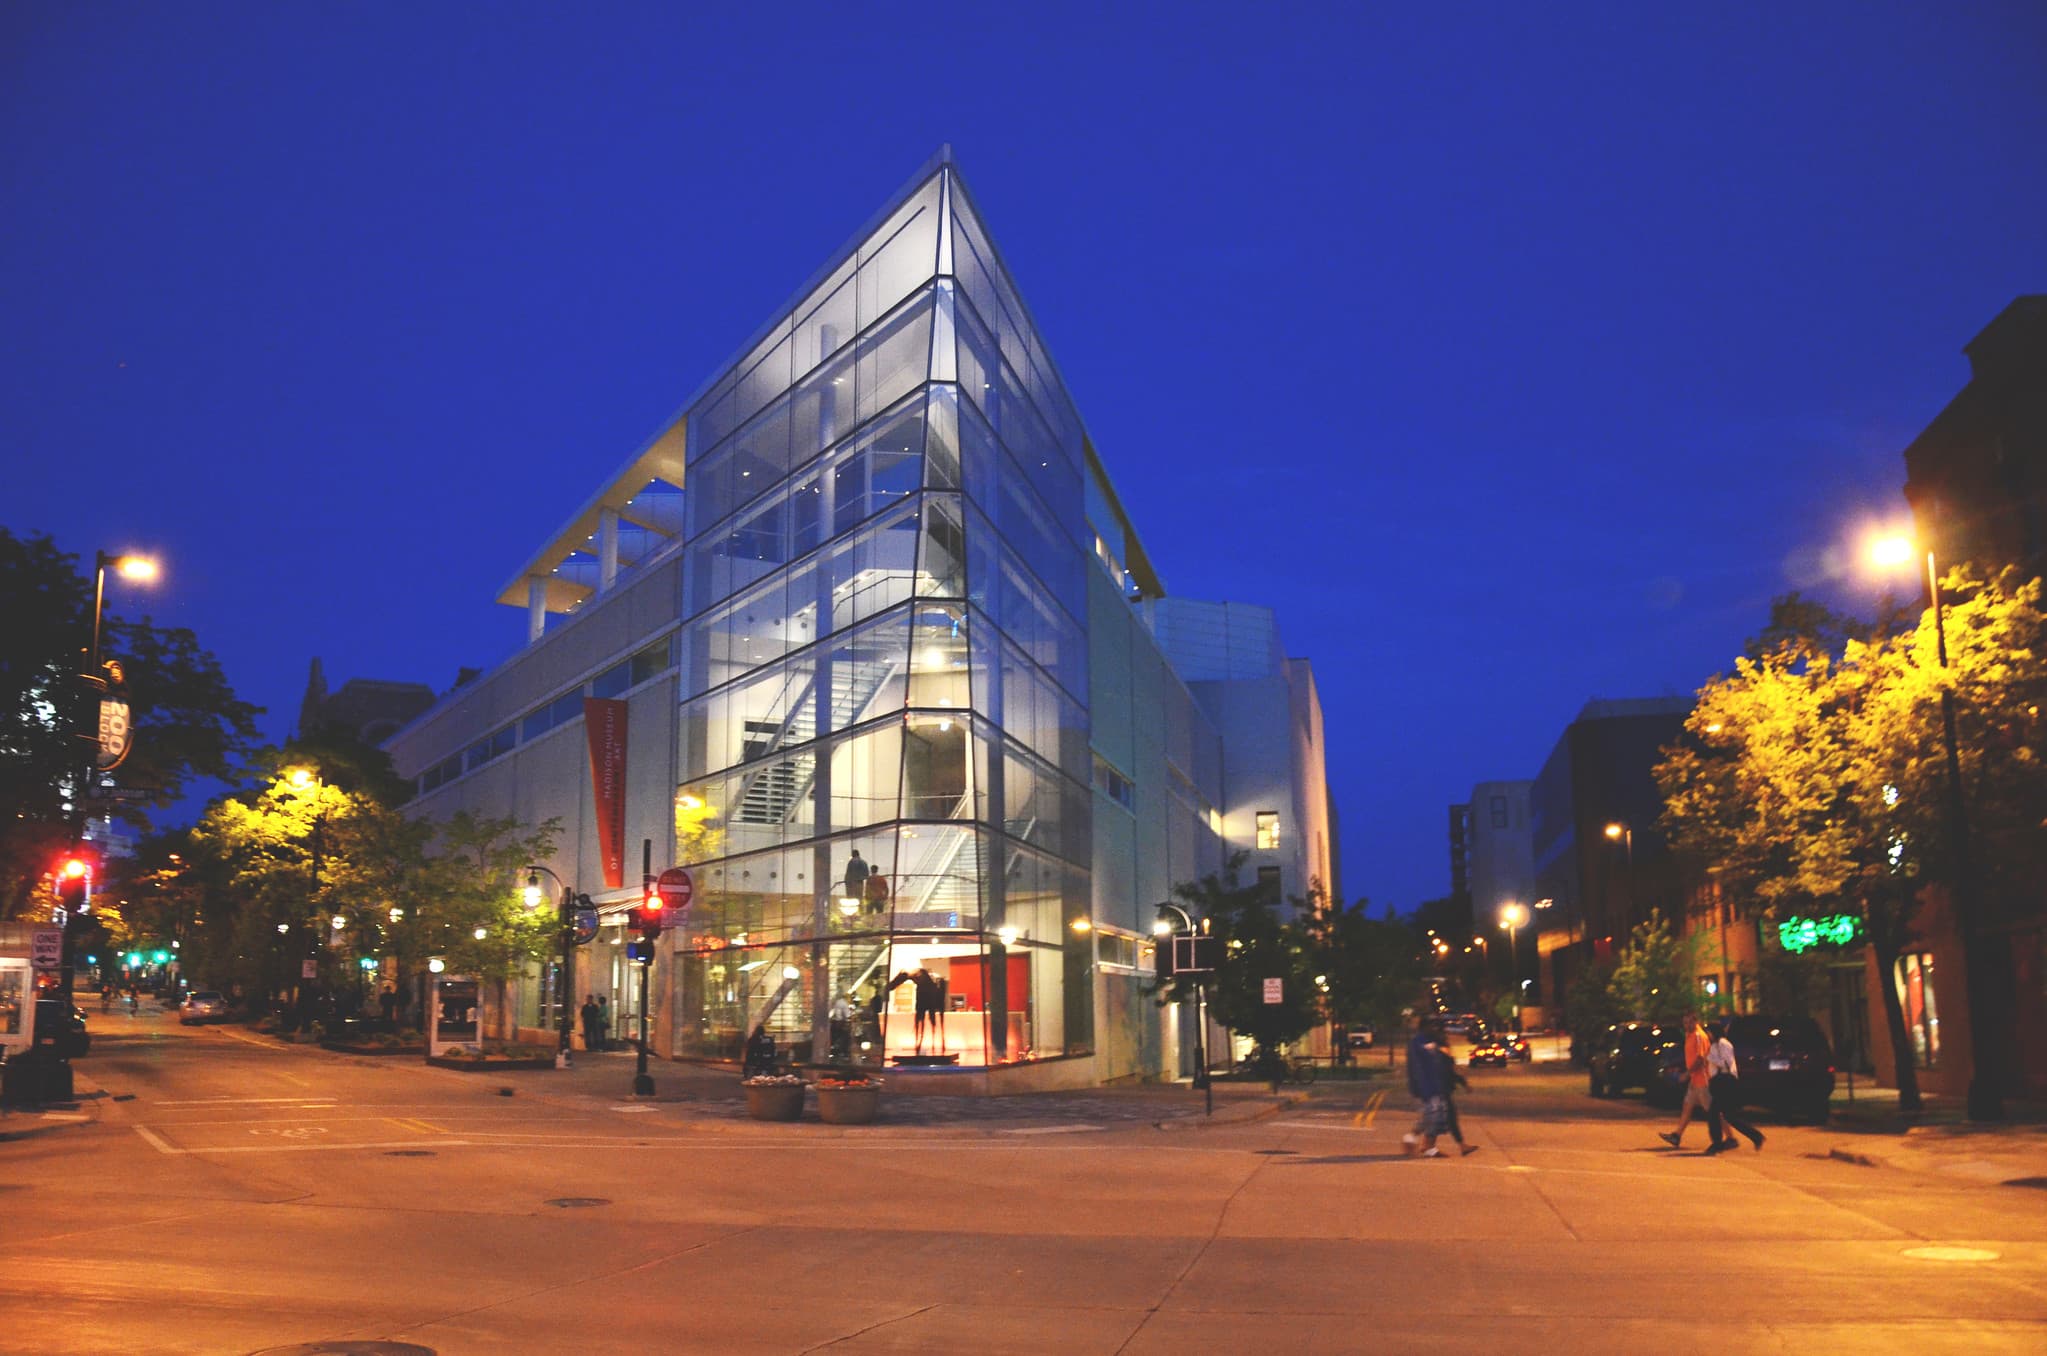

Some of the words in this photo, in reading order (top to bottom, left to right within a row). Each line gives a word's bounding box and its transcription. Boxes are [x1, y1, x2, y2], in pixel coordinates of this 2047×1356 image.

[109, 702, 130, 755] 200
[36, 933, 58, 944] ONE
[35, 944, 57, 953] WAY
